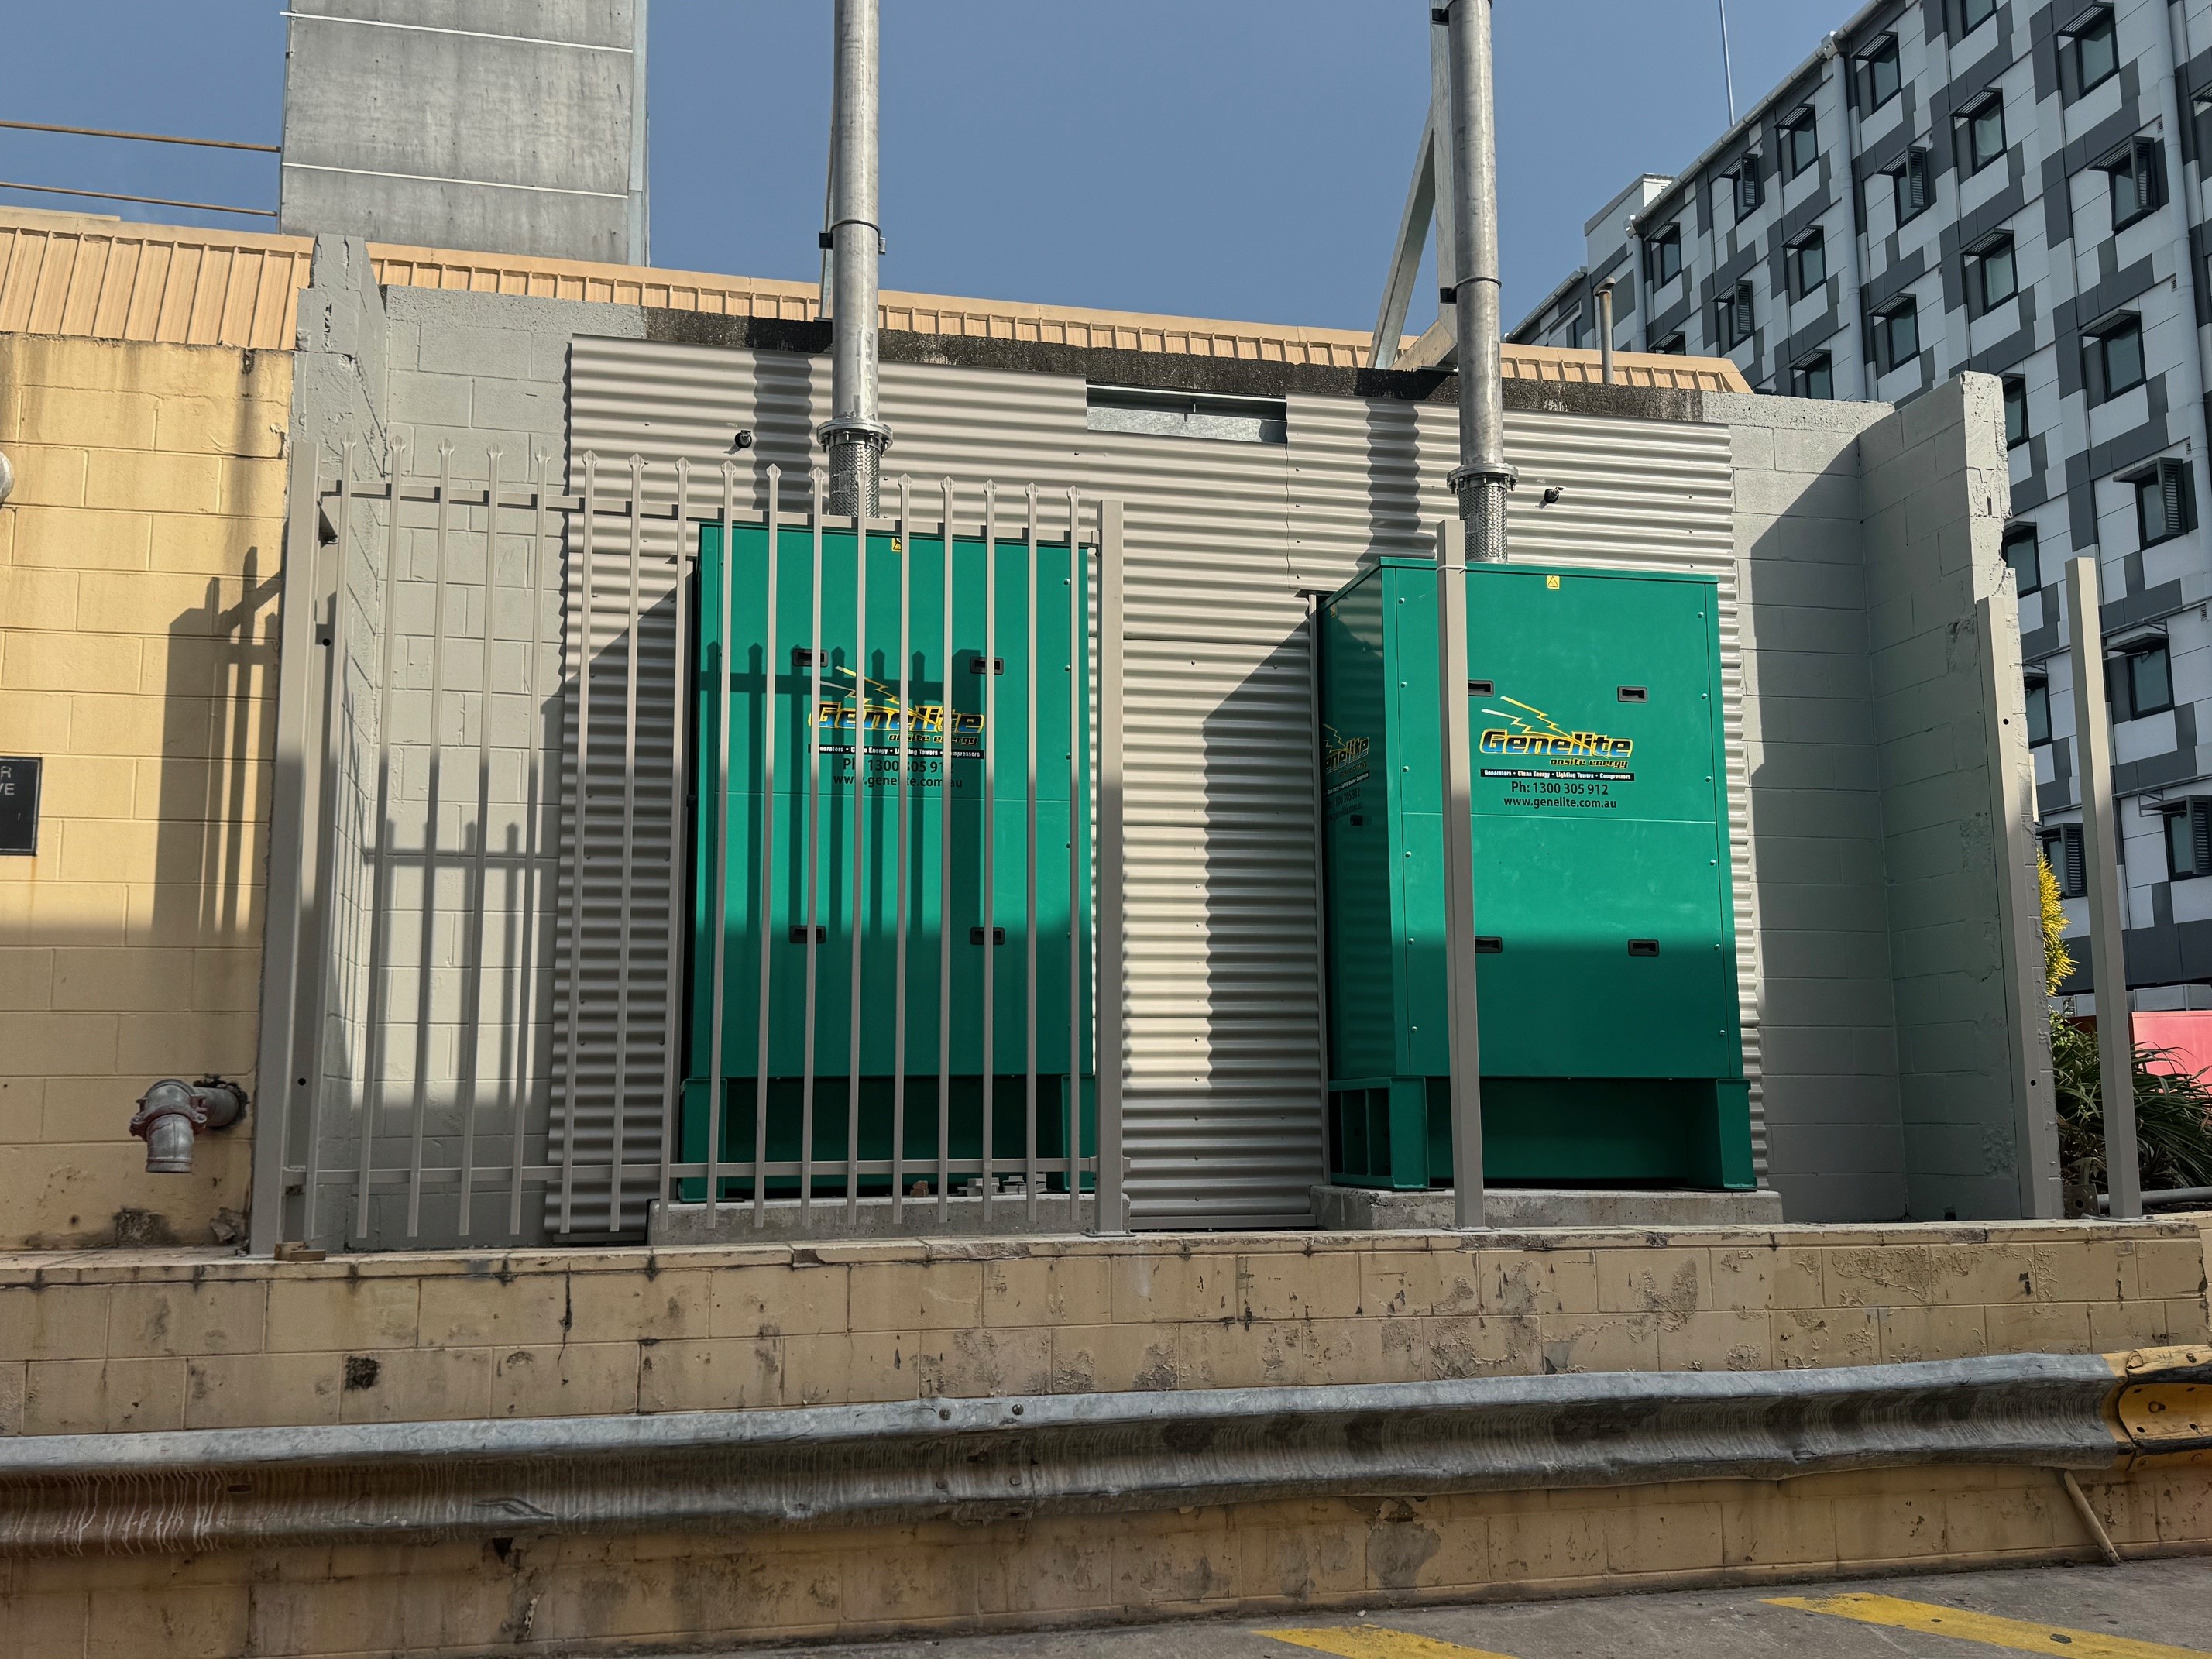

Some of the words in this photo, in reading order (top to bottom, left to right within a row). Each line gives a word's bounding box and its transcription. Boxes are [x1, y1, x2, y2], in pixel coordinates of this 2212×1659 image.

[807, 701, 985, 733] Genelie
[1479, 728, 1633, 757] Genelite
[867, 760, 899, 771] 1300
[1511, 781, 1530, 793] Ph:
[1533, 782, 1561, 794] 1300
[1564, 783, 1585, 795] 305
[1587, 784, 1609, 795] 912
[1503, 796, 1617, 809] www.genelite.com.au
